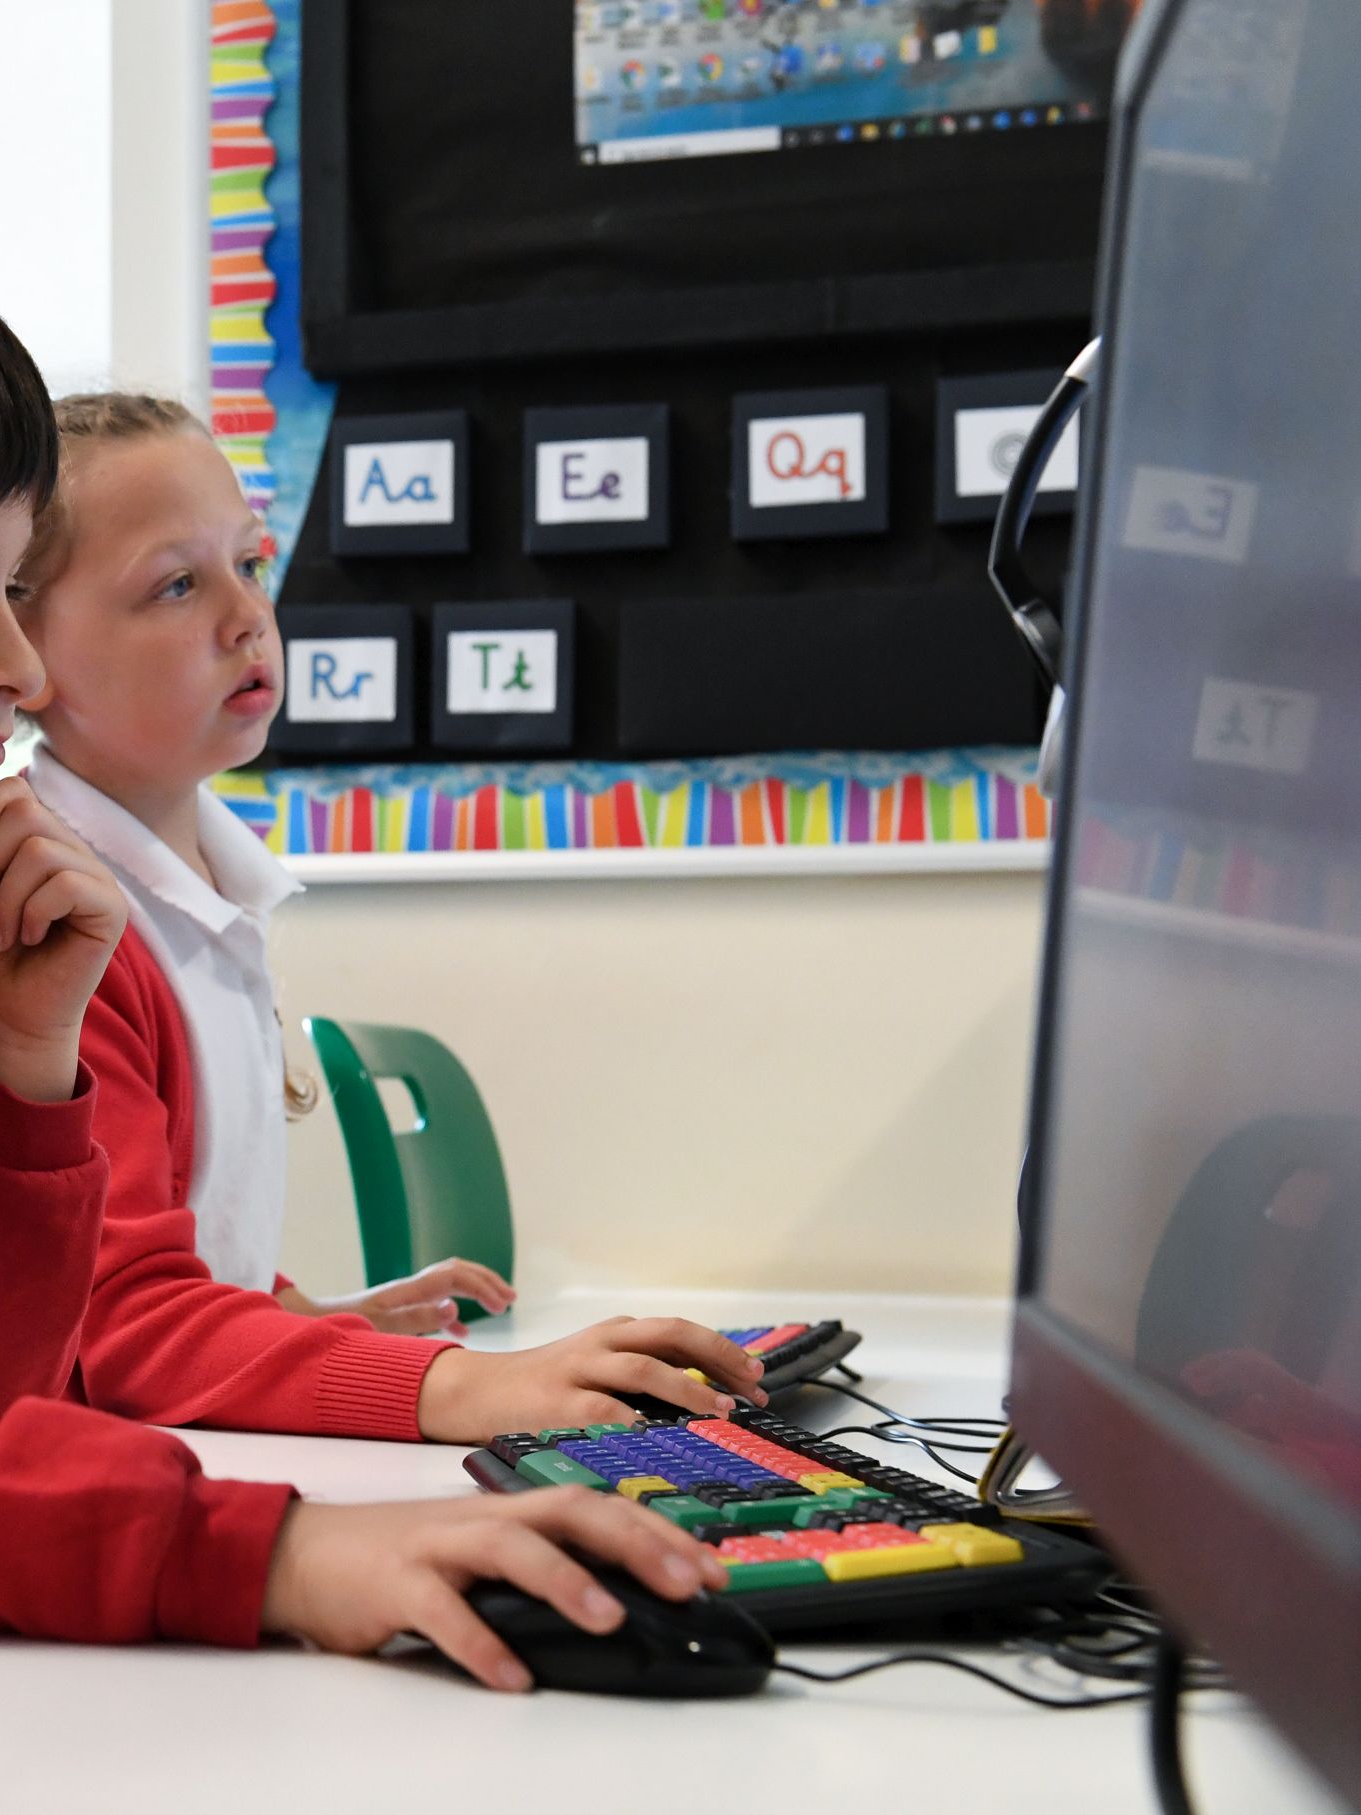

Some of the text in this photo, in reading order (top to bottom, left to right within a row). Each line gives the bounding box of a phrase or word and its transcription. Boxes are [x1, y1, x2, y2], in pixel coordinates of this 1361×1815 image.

[358, 457, 437, 504] Aa
[562, 452, 622, 501] Ee
[767, 431, 852, 500] Qq
[310, 652, 373, 700] Rr
[471, 643, 534, 692] Tt
